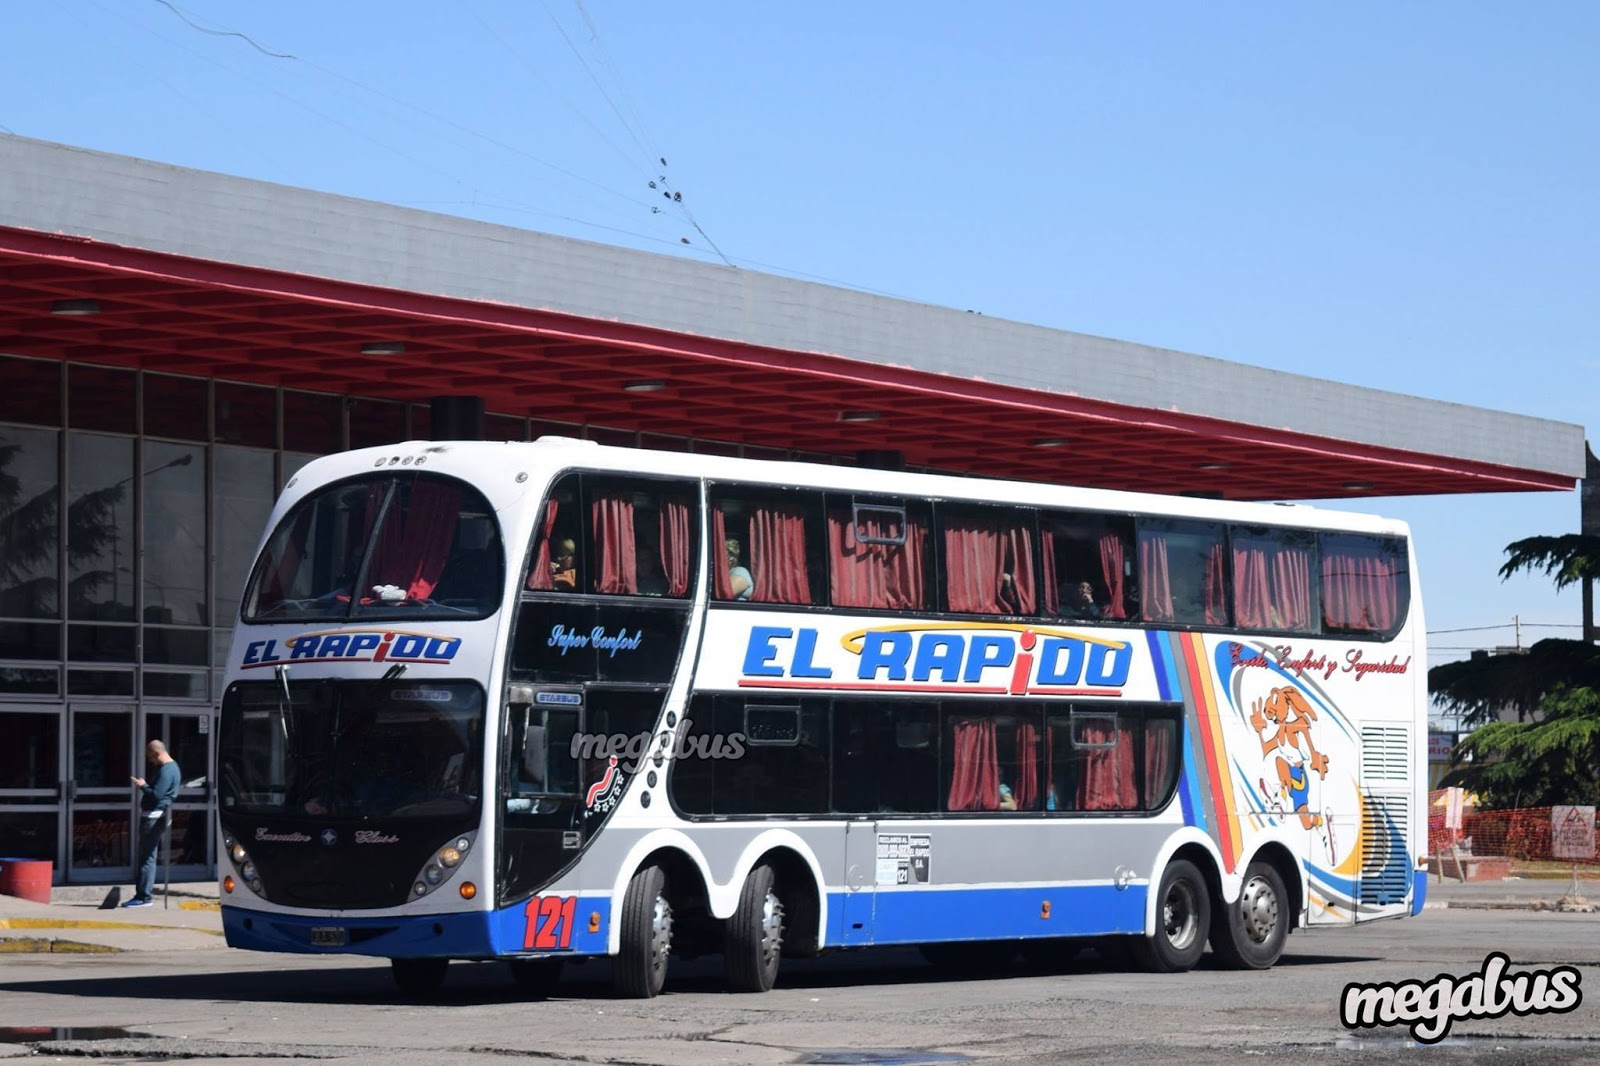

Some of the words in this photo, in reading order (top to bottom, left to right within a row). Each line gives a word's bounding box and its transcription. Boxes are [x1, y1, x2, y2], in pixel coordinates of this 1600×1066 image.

[243, 639, 279, 664] EL
[548, 624, 590, 656] Super
[591, 625, 642, 658] Confort
[742, 626, 832, 677] EL
[1275, 645, 1327, 677] Confort
[1323, 660, 1338, 681] y
[1342, 649, 1412, 681] Seguridad
[395, 691, 449, 700] STARBUS
[538, 693, 580, 704] STARBUS
[898, 869, 908, 882] 121
[524, 896, 577, 949] 121
